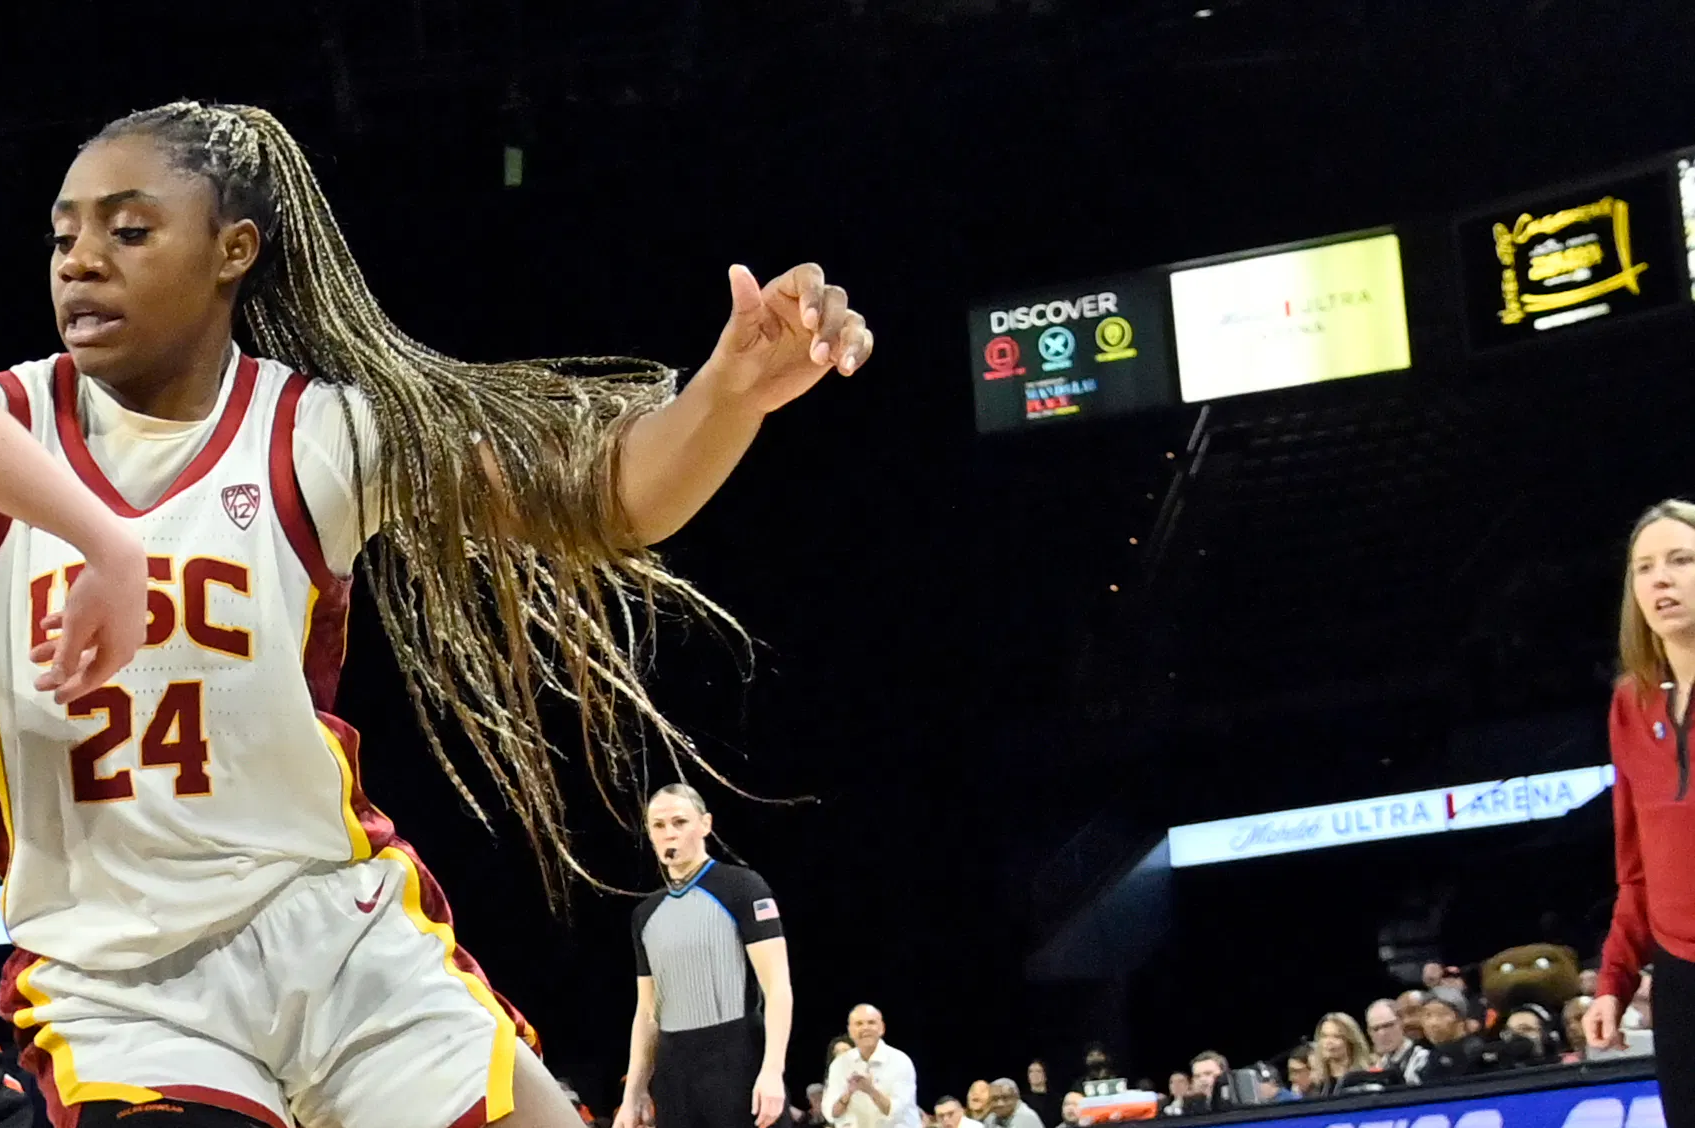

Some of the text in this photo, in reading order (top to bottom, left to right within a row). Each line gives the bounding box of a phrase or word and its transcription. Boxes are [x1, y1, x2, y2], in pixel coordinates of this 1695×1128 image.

[990, 291, 1119, 334] DISCOVER
[66, 679, 214, 804] 24
[1331, 800, 1432, 836] ULTRA
[1468, 780, 1574, 815] ARENA
